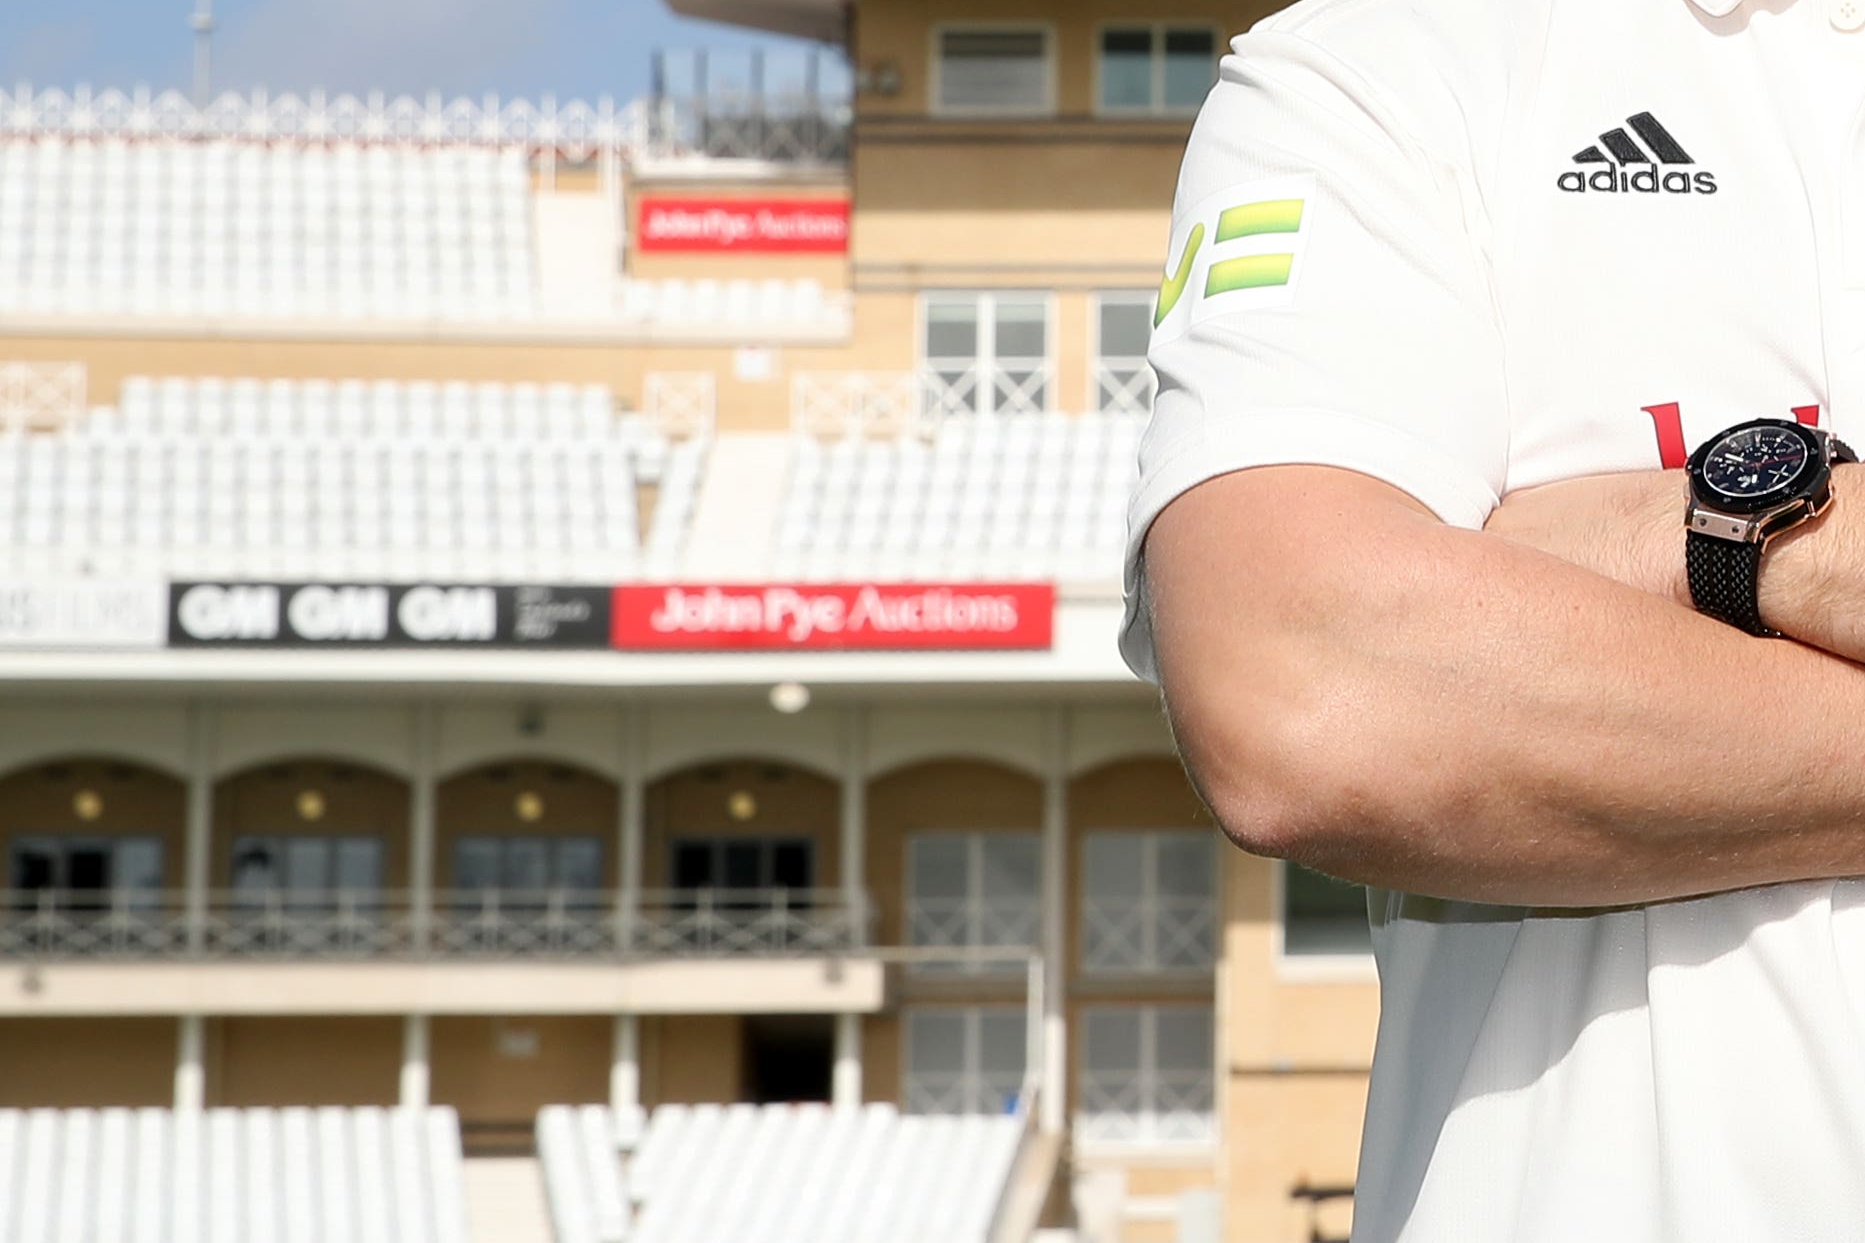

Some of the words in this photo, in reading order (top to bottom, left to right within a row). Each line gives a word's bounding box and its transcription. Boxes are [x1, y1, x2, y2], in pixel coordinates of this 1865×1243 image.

[1557, 161, 1718, 194] adidas
[650, 587, 763, 633] John
[763, 588, 848, 642] Pye
[845, 586, 1019, 633] Auctions
